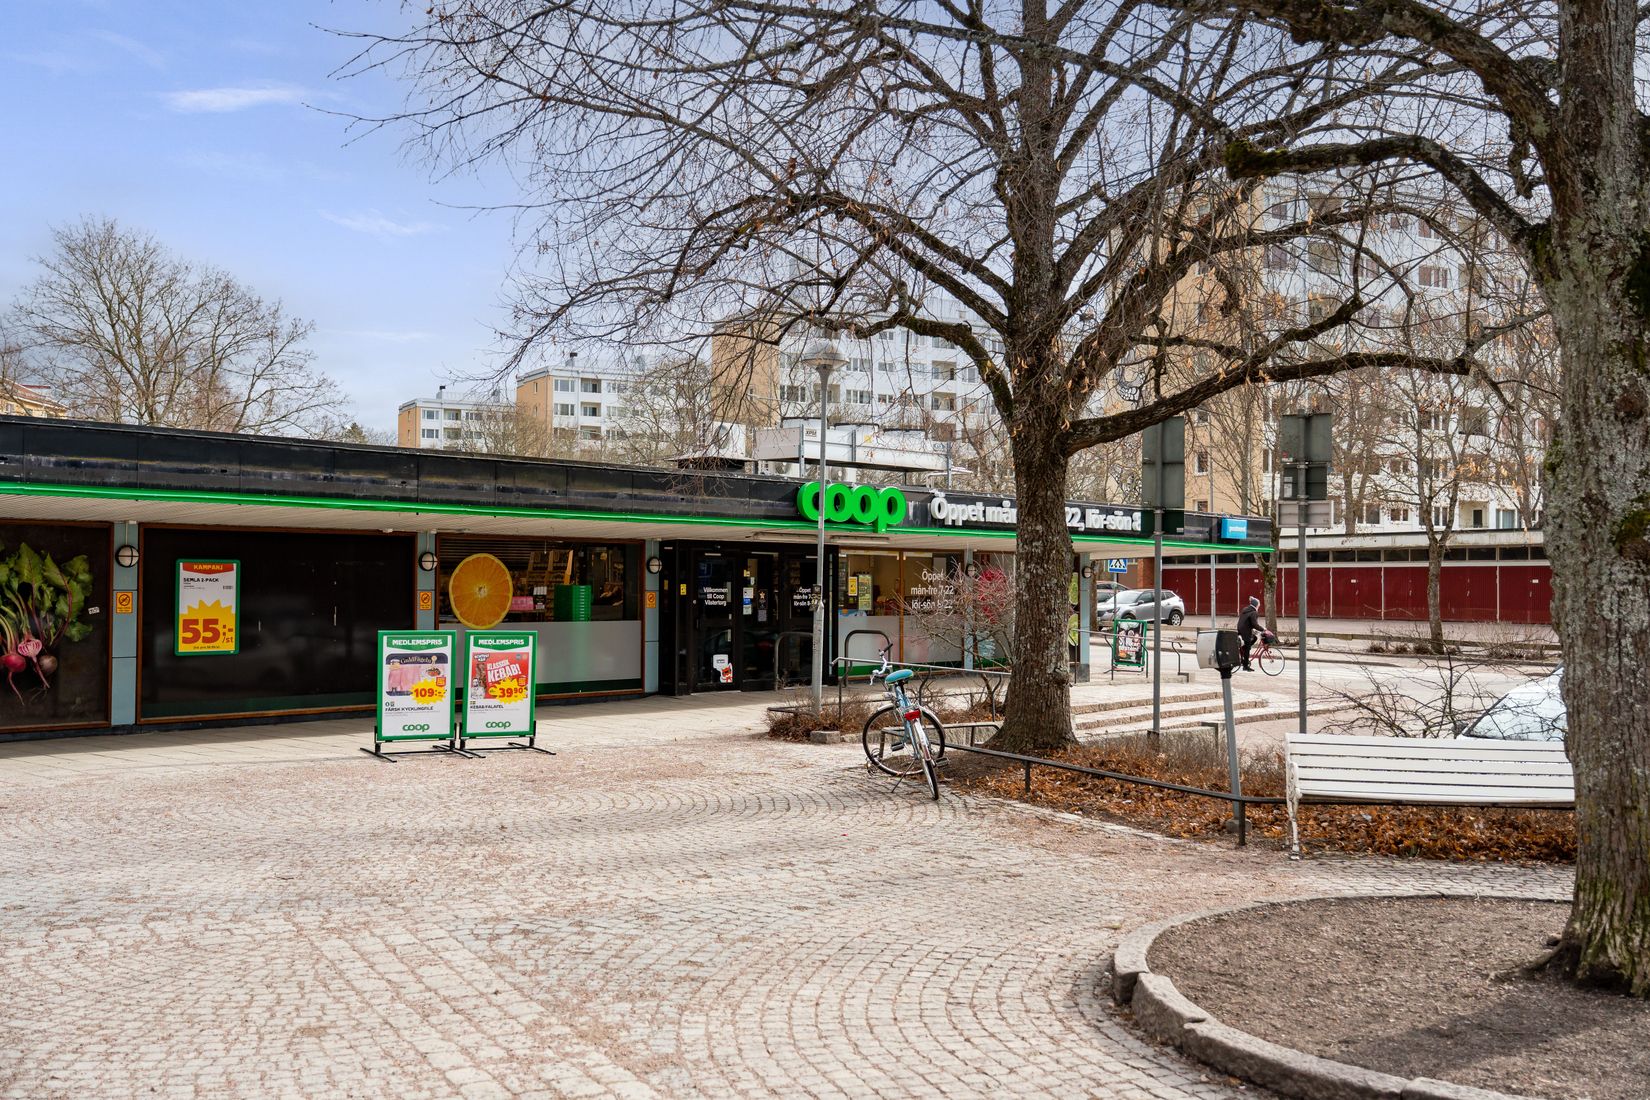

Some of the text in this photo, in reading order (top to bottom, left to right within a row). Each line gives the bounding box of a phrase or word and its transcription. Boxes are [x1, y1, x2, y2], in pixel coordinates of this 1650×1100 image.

[797, 481, 906, 534] coop
[929, 489, 984, 526] Öppet
[1065, 507, 1085, 532] 22,
[1085, 508, 1132, 531] lör-sön
[1132, 511, 1141, 532] 8
[921, 568, 944, 583] Öppet
[910, 583, 937, 595] mån-fre
[704, 599, 727, 607] Västertorg
[912, 599, 935, 609] lör-sön
[488, 663, 522, 682] KEBAB!
[402, 723, 430, 732] coop
[485, 721, 511, 729] coop
